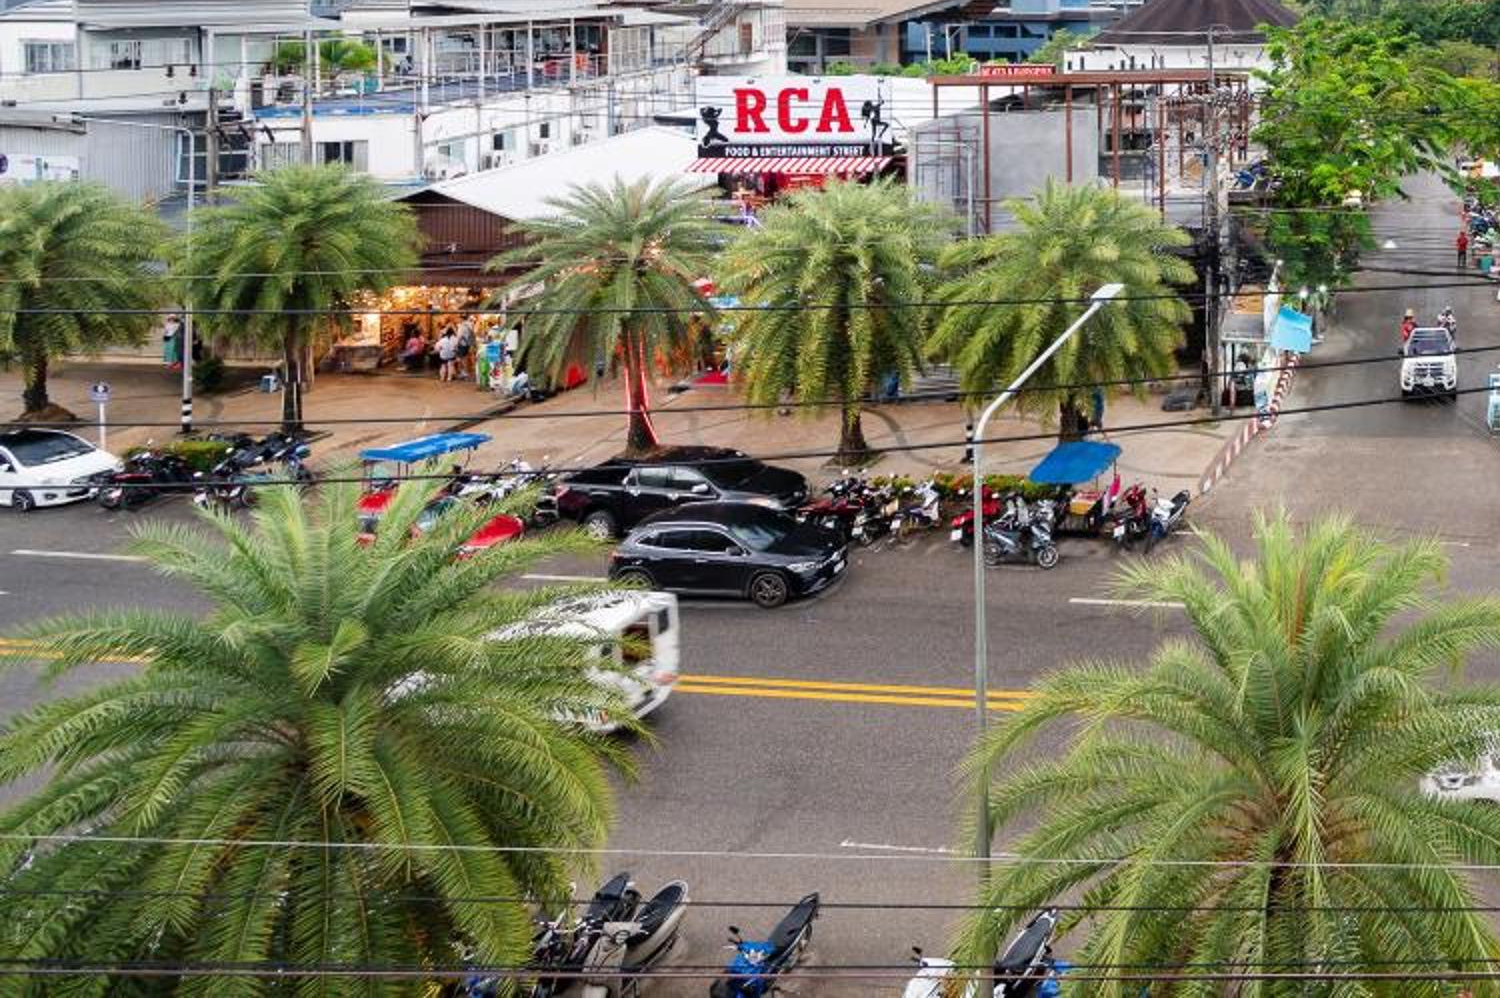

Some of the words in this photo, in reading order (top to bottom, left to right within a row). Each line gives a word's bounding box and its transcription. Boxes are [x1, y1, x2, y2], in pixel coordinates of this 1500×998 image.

[733, 87, 855, 134] RCA
[725, 145, 750, 158] FOOD
[759, 145, 831, 158] ENTERTAINMENT
[833, 145, 865, 158] STREET
